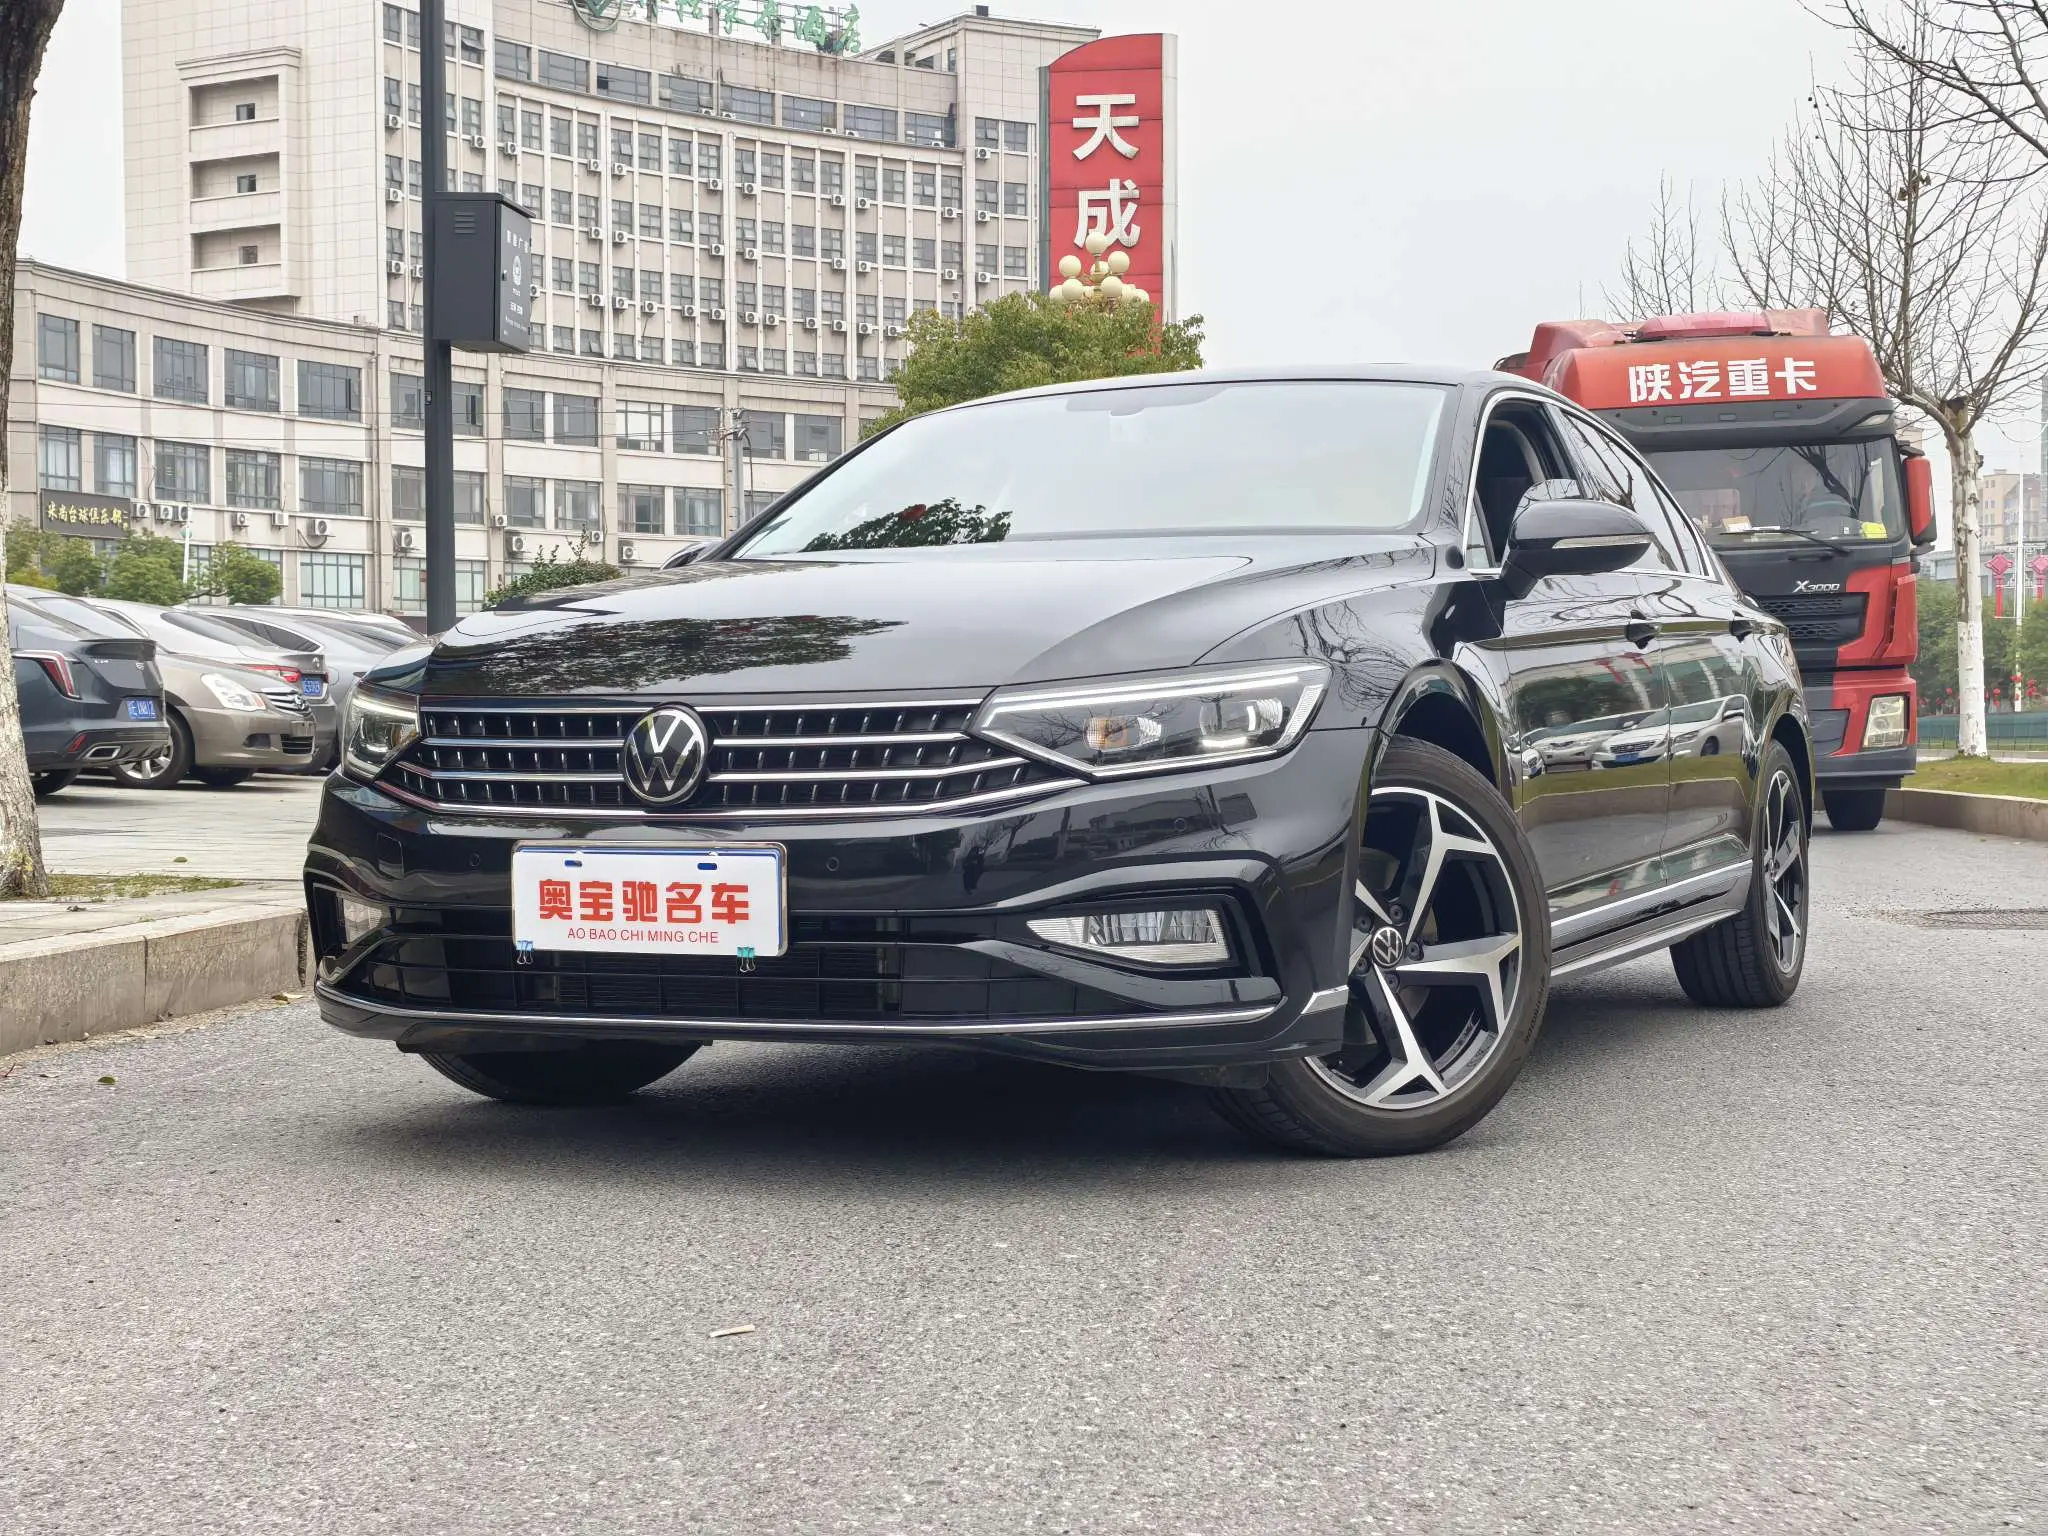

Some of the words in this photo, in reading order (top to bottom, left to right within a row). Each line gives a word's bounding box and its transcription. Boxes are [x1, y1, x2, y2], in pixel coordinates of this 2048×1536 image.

[1072, 93, 1141, 249] 天成
[1628, 357, 1817, 403] 陕汽重卡
[1792, 579, 1840, 594] X3000
[538, 879, 749, 925] 奥宝驰名车
[567, 927, 586, 940] AO
[589, 928, 617, 941] BAO
[620, 929, 644, 942] CHI
[647, 930, 684, 943] MING
[688, 931, 719, 944] CHE
